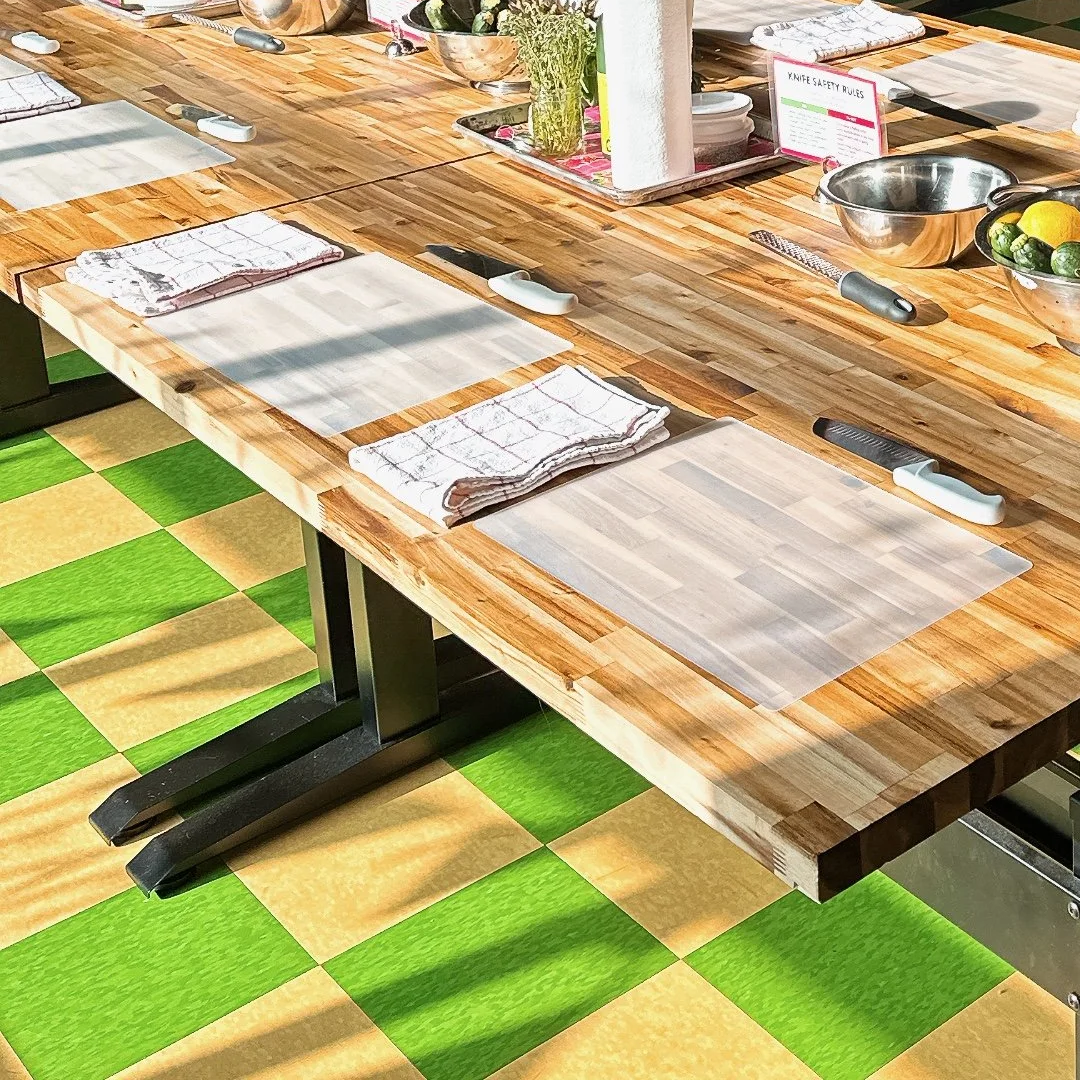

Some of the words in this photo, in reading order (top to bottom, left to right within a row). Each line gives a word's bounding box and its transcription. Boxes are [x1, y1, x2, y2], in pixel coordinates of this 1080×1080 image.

[787, 71, 811, 85] KNIFE
[812, 77, 840, 92] SAFETY
[842, 84, 865, 99] RULES
